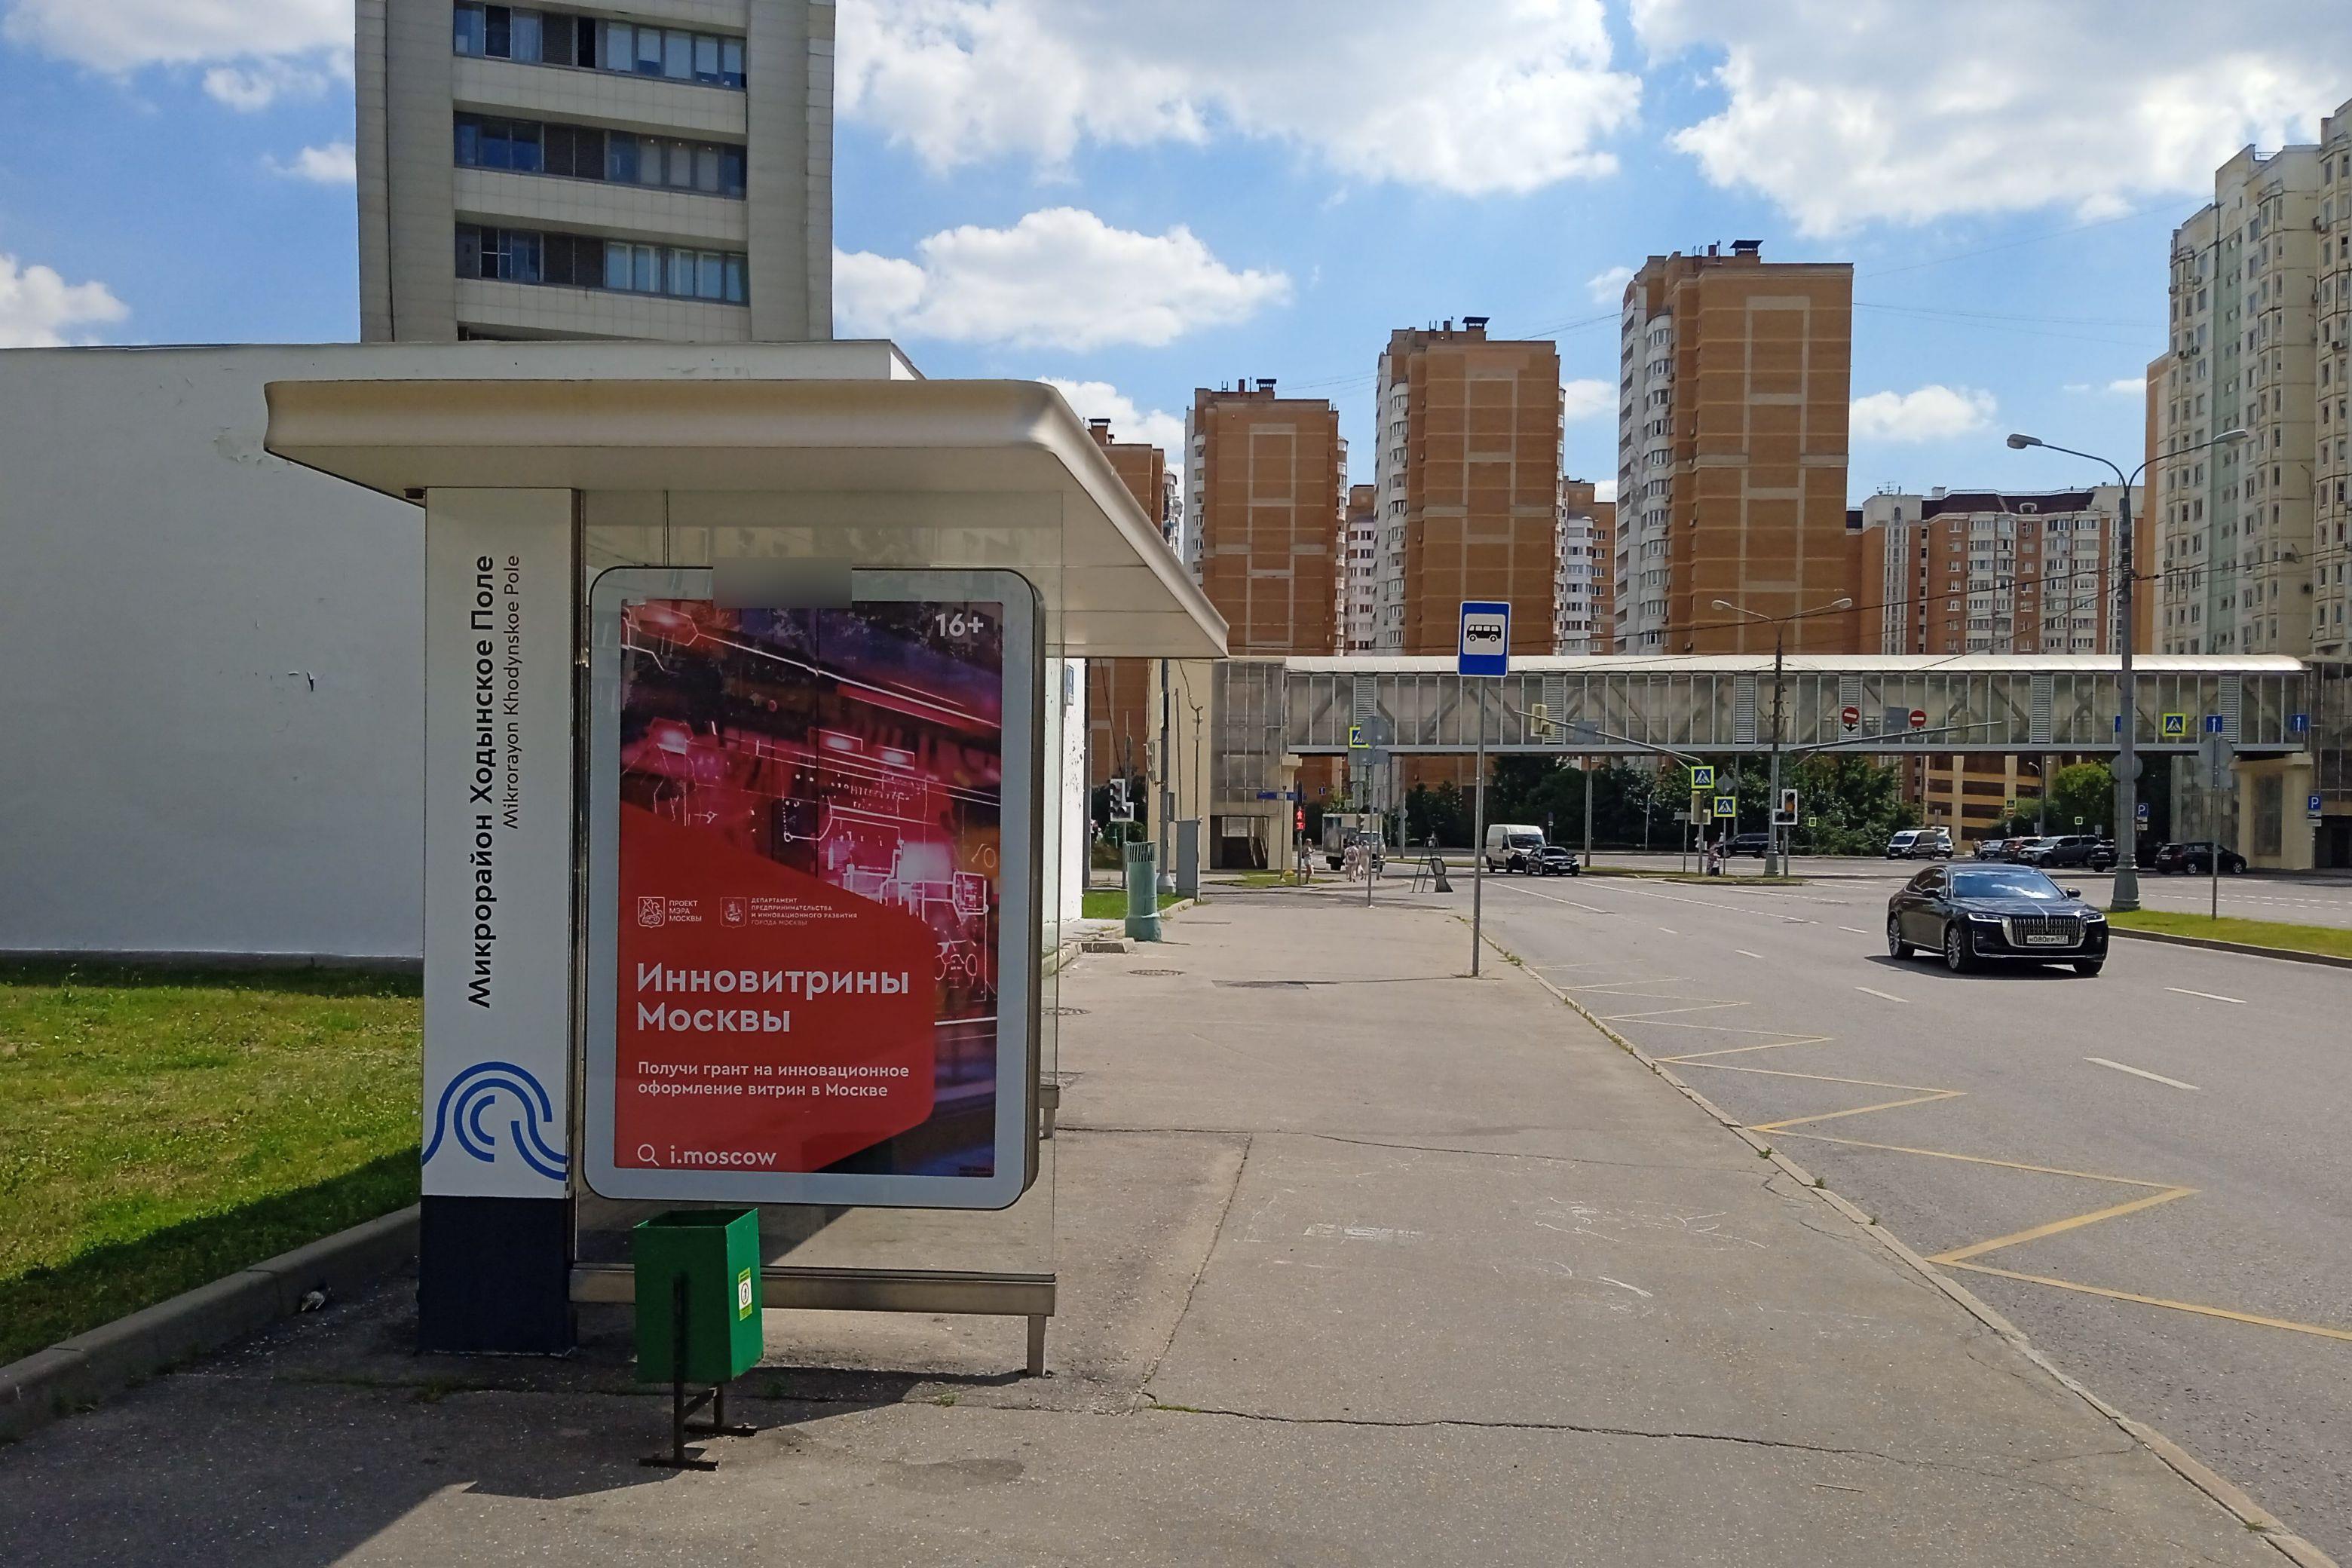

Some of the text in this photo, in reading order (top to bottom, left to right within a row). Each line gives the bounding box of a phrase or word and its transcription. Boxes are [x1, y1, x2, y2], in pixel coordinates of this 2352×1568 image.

[935, 613, 984, 638] 16+
[502, 555, 523, 829] Mikrorayon Khodynskoe Pole
[468, 555, 498, 1009] Микрорайон Ходынское Поле
[638, 962, 909, 1000] Инновитрины
[638, 1001, 790, 1033] Москвы
[638, 1061, 909, 1080] Получи грант на инновационное
[638, 1081, 888, 1100] оформление витрин в Москве
[670, 1144, 777, 1166] i.moscow
